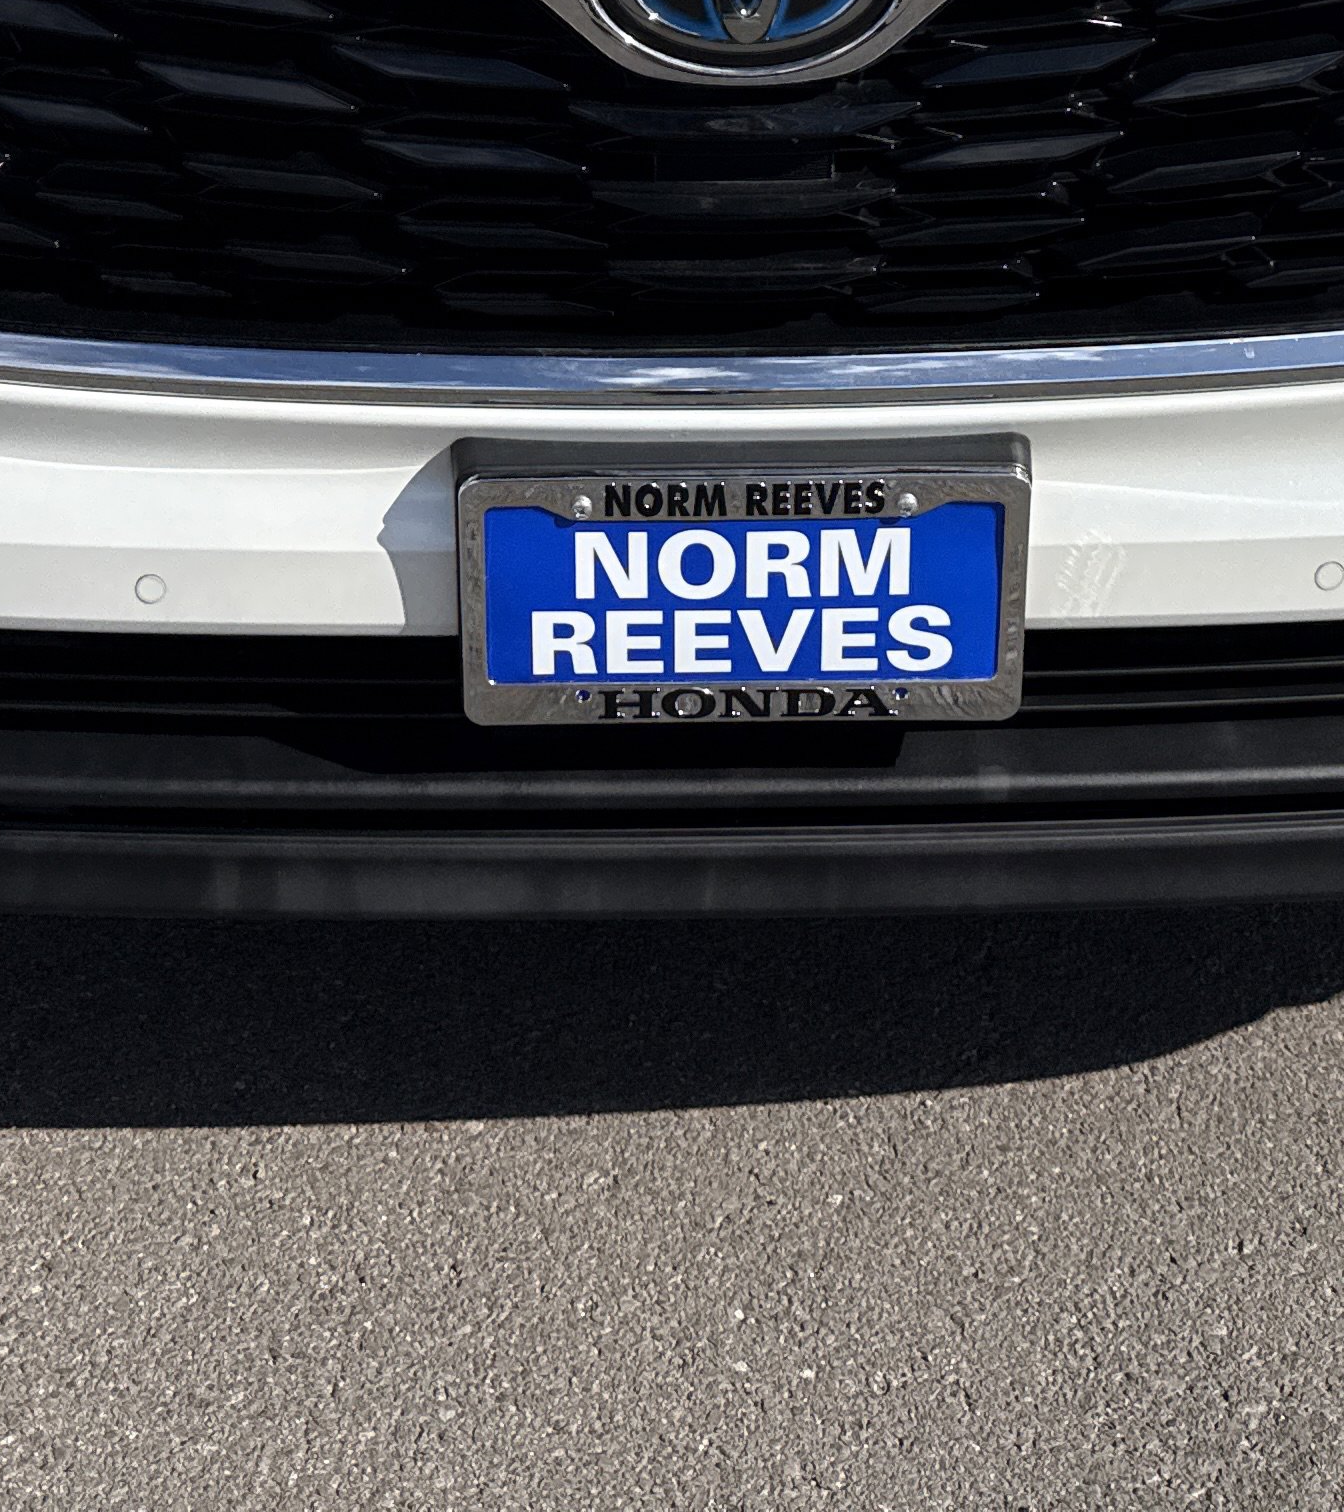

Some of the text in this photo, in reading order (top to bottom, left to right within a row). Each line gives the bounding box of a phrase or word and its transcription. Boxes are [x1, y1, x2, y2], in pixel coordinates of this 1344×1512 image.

[603, 479, 886, 518] NORM REEVES
[574, 527, 912, 600] NORM
[531, 604, 953, 676] REEVES
[597, 688, 899, 720] HONDA
